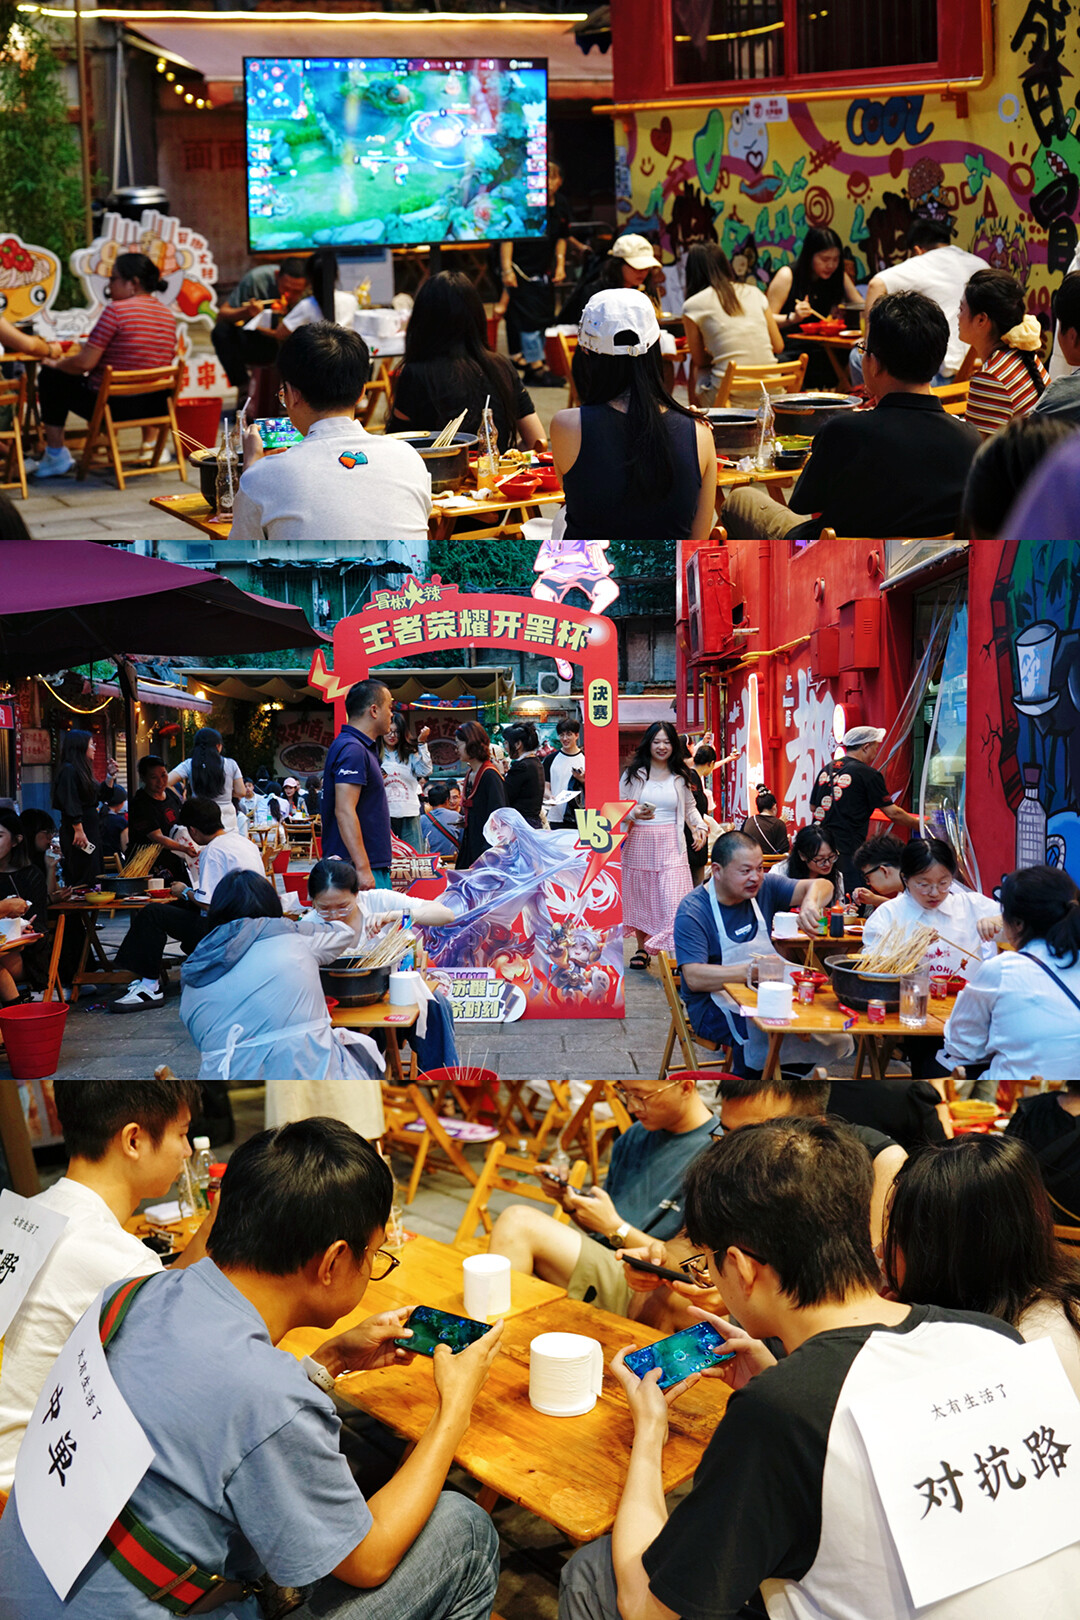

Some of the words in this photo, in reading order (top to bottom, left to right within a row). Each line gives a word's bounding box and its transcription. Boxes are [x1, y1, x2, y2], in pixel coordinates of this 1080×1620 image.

[372, 577, 445, 612] 冒椒火辣
[359, 609, 595, 655] 王者荣耀开黑杯
[592, 685, 609, 720] 决赛
[574, 808, 612, 843] VS
[452, 978, 505, 997] 苏醒了
[77, 1348, 102, 1421] 太有生活了
[930, 1383, 1008, 1421] 太有生活了
[41, 1382, 78, 1488] 中单
[913, 1424, 1073, 1521] 对抗路
